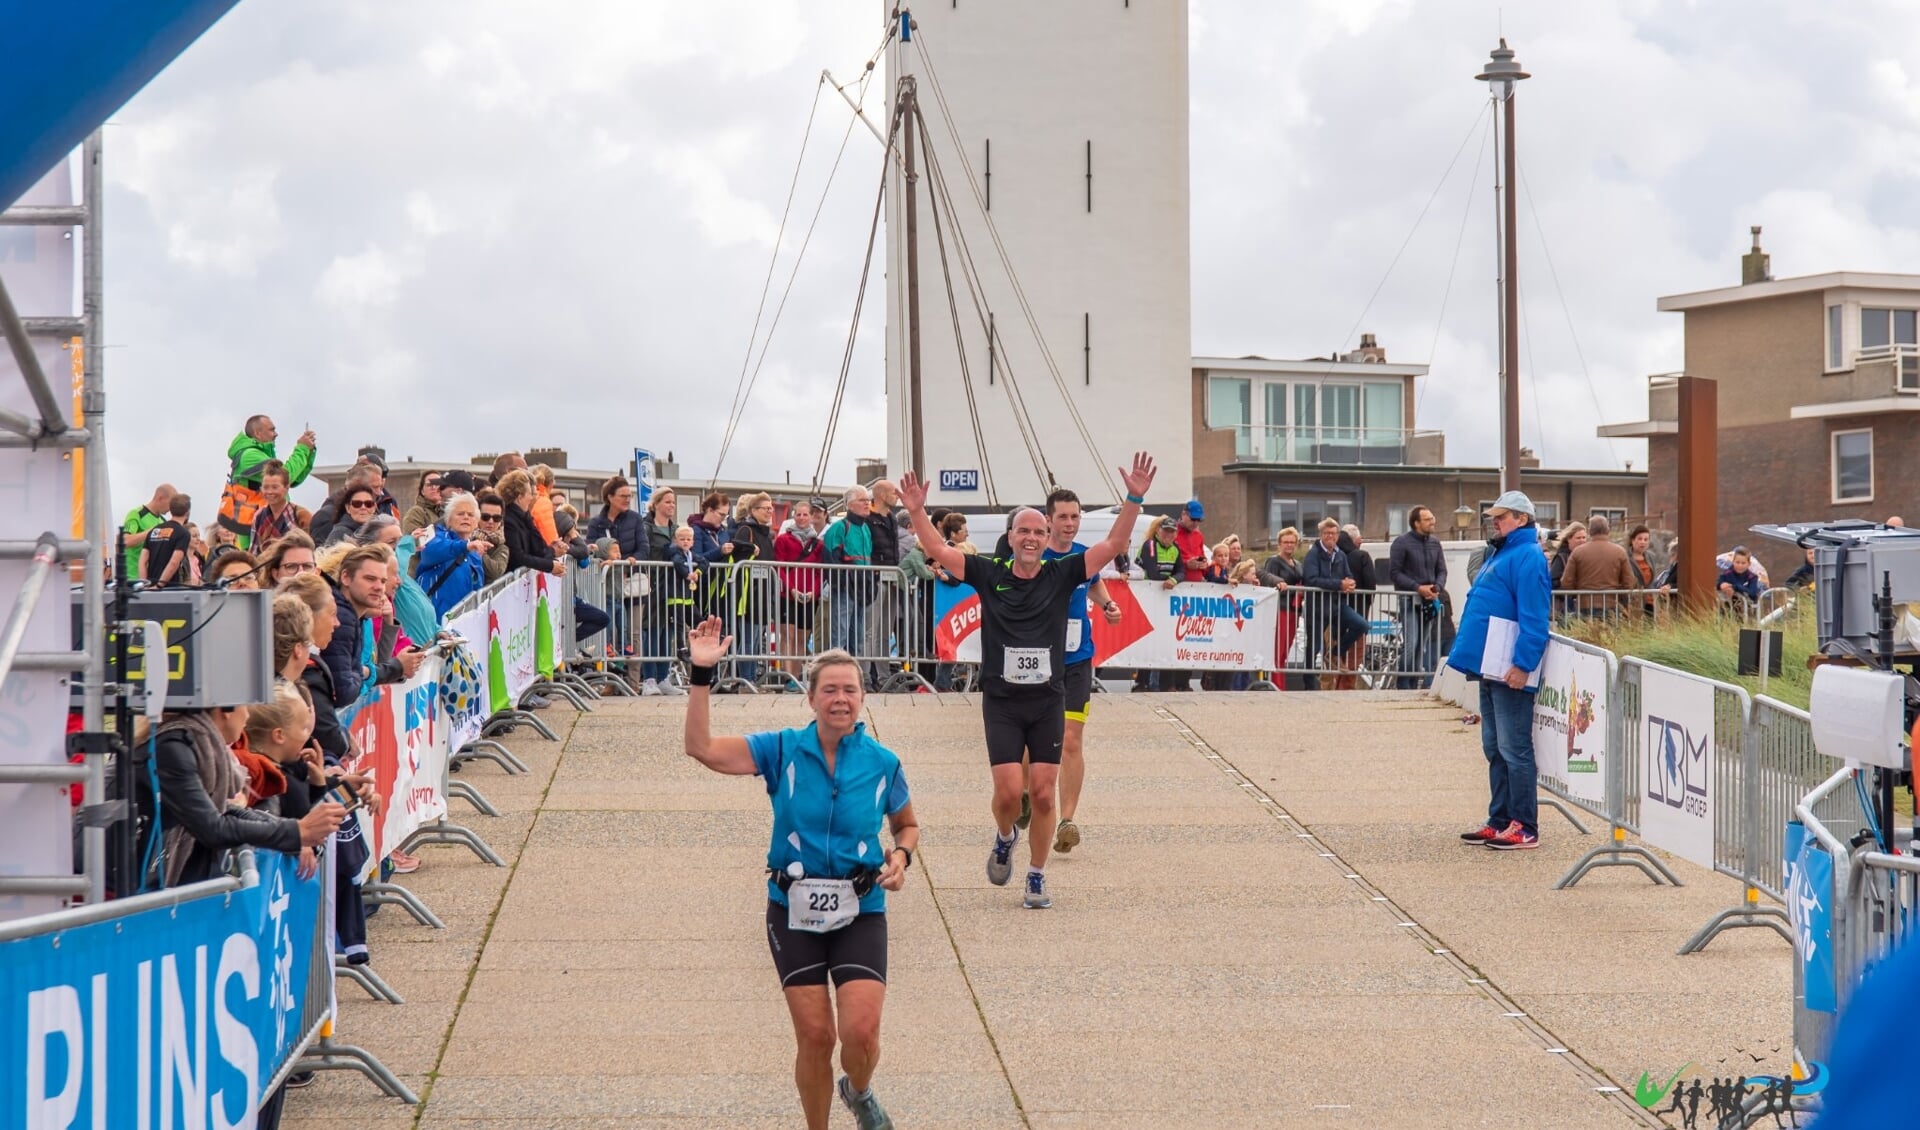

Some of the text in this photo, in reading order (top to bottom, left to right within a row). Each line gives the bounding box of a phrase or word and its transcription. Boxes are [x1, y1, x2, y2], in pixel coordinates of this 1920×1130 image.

[942, 471, 976, 486] OPEN
[1170, 595, 1255, 620] RUNNING
[1176, 603, 1216, 641] Center
[1017, 657, 1040, 670] 338
[1177, 648, 1244, 665] We are running
[1685, 795, 1707, 819] GROEP
[808, 892, 840, 912] 223
